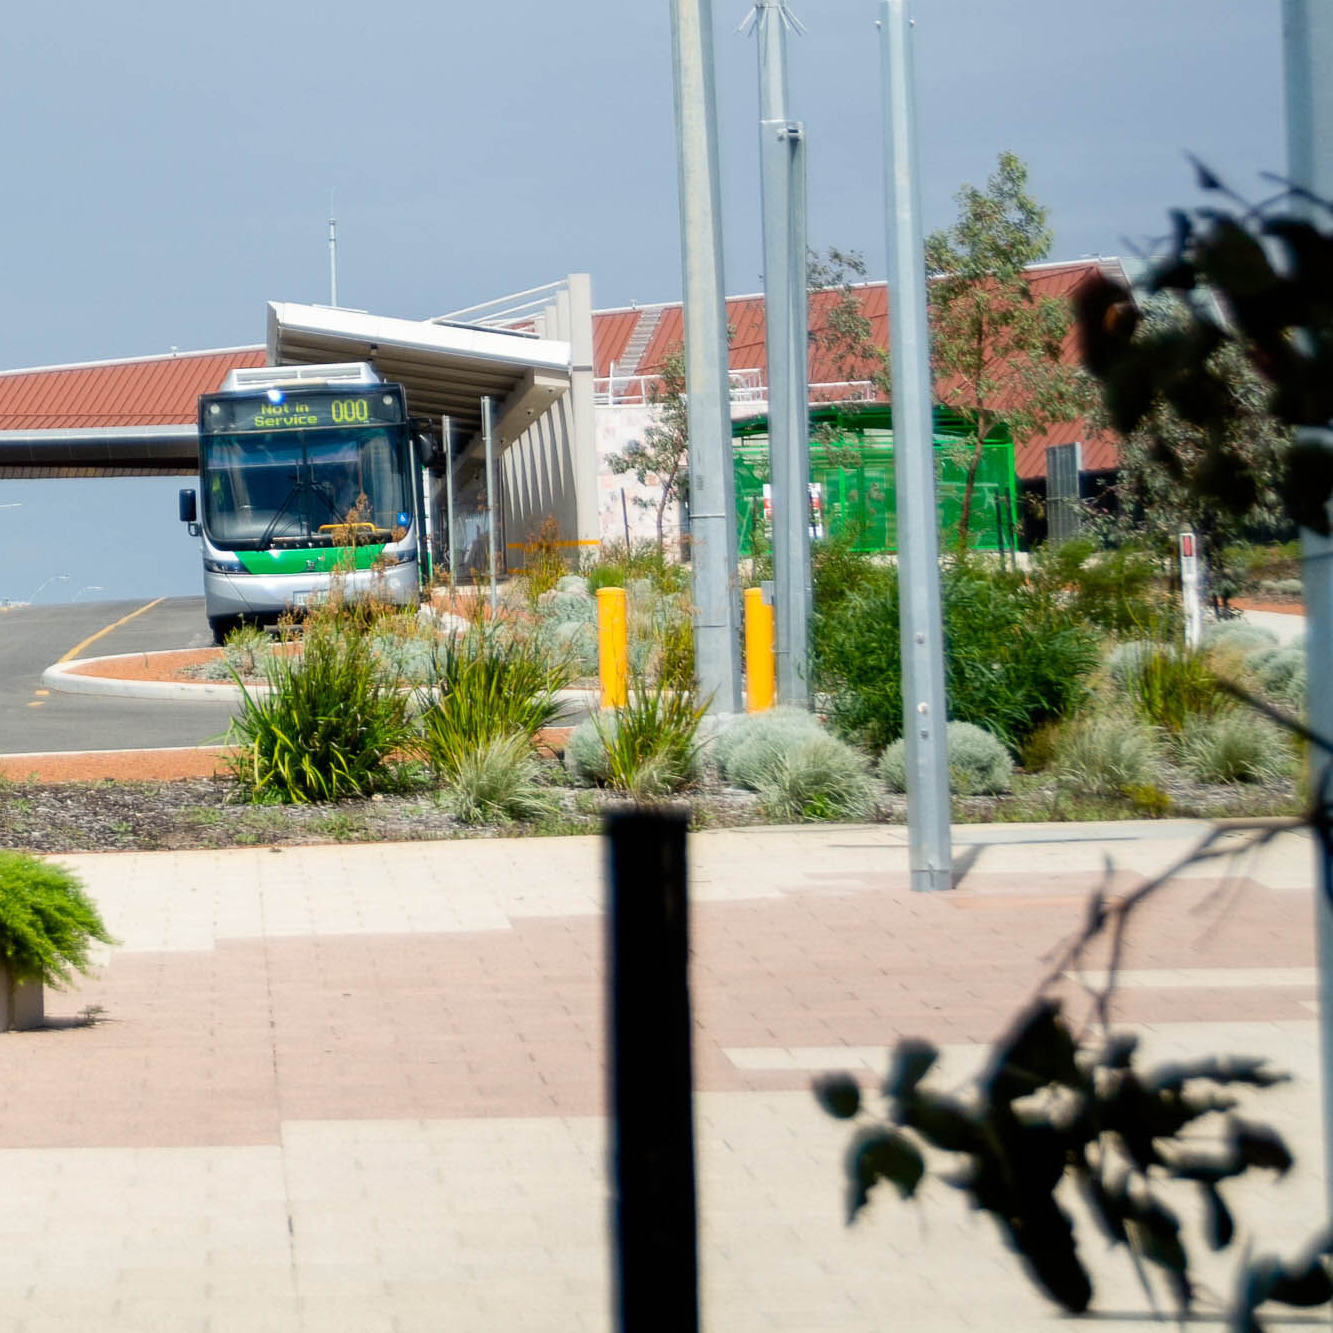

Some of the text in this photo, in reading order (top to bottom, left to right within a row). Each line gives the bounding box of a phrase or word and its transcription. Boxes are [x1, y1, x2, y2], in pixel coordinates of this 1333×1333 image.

[261, 402, 310, 415] Not in
[331, 399, 368, 422] 000
[254, 413, 318, 427] Service
